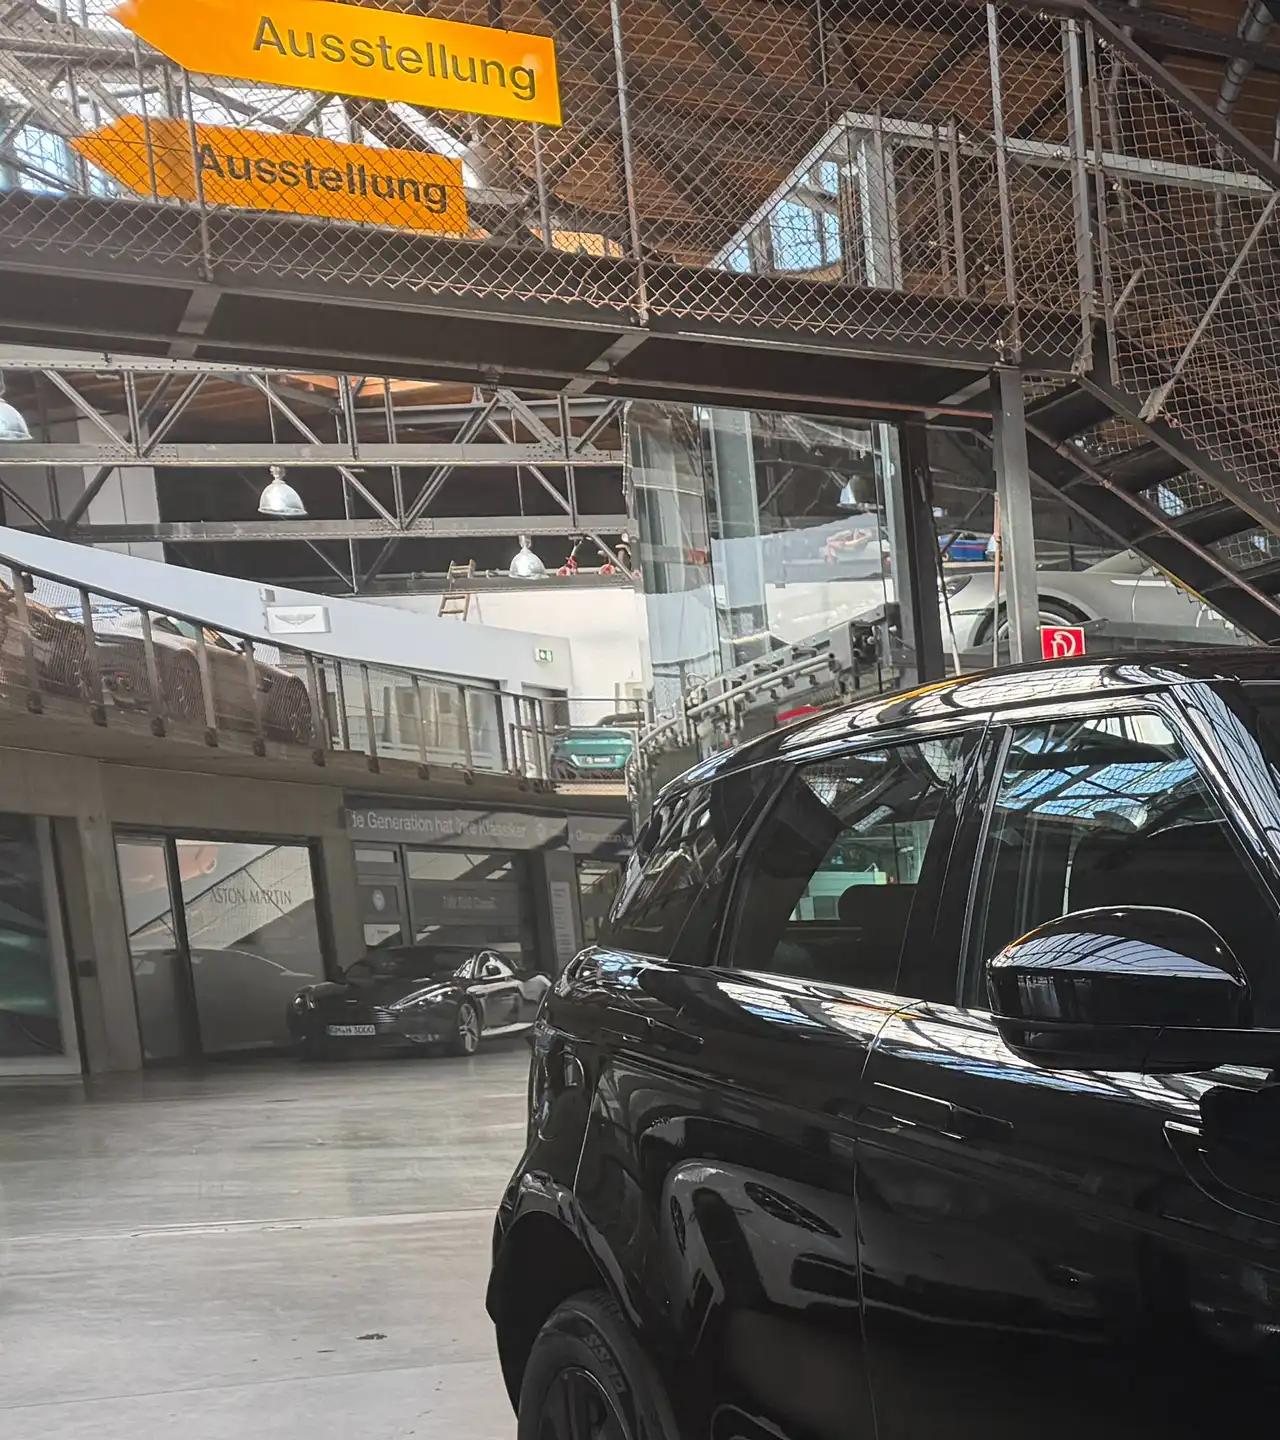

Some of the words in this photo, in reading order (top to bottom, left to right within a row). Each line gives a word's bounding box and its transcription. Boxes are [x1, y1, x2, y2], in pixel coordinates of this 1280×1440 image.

[252, 15, 537, 101] Ausstellung
[199, 143, 448, 214] Ausstellung
[367, 811, 434, 832] Generation
[211, 888, 246, 904] ASTON
[250, 889, 292, 905] MARTIN
